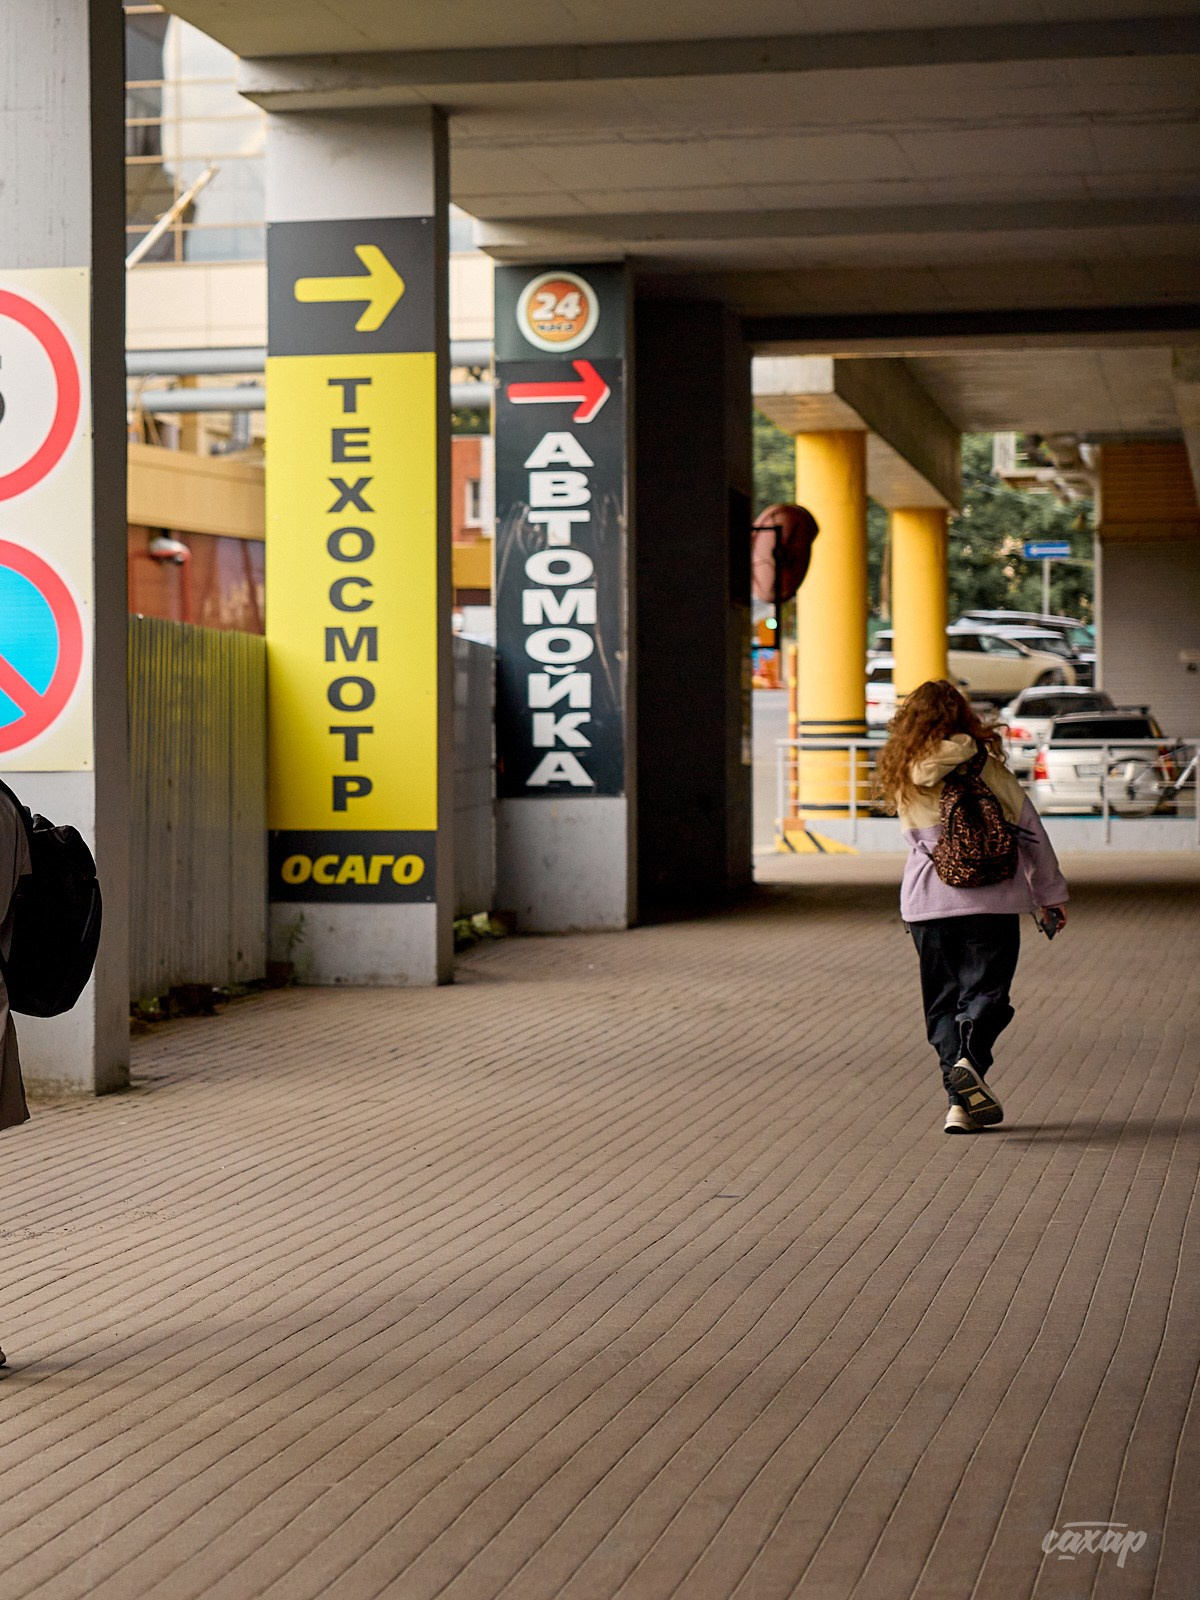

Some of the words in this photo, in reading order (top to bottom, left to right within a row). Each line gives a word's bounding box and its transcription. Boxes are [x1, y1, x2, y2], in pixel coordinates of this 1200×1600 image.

[532, 291, 582, 321] 24
[323, 377, 379, 813] ТЕХОСМОТР
[522, 431, 598, 787] АВТОМОЙКА
[281, 853, 425, 886] ОСАГО
